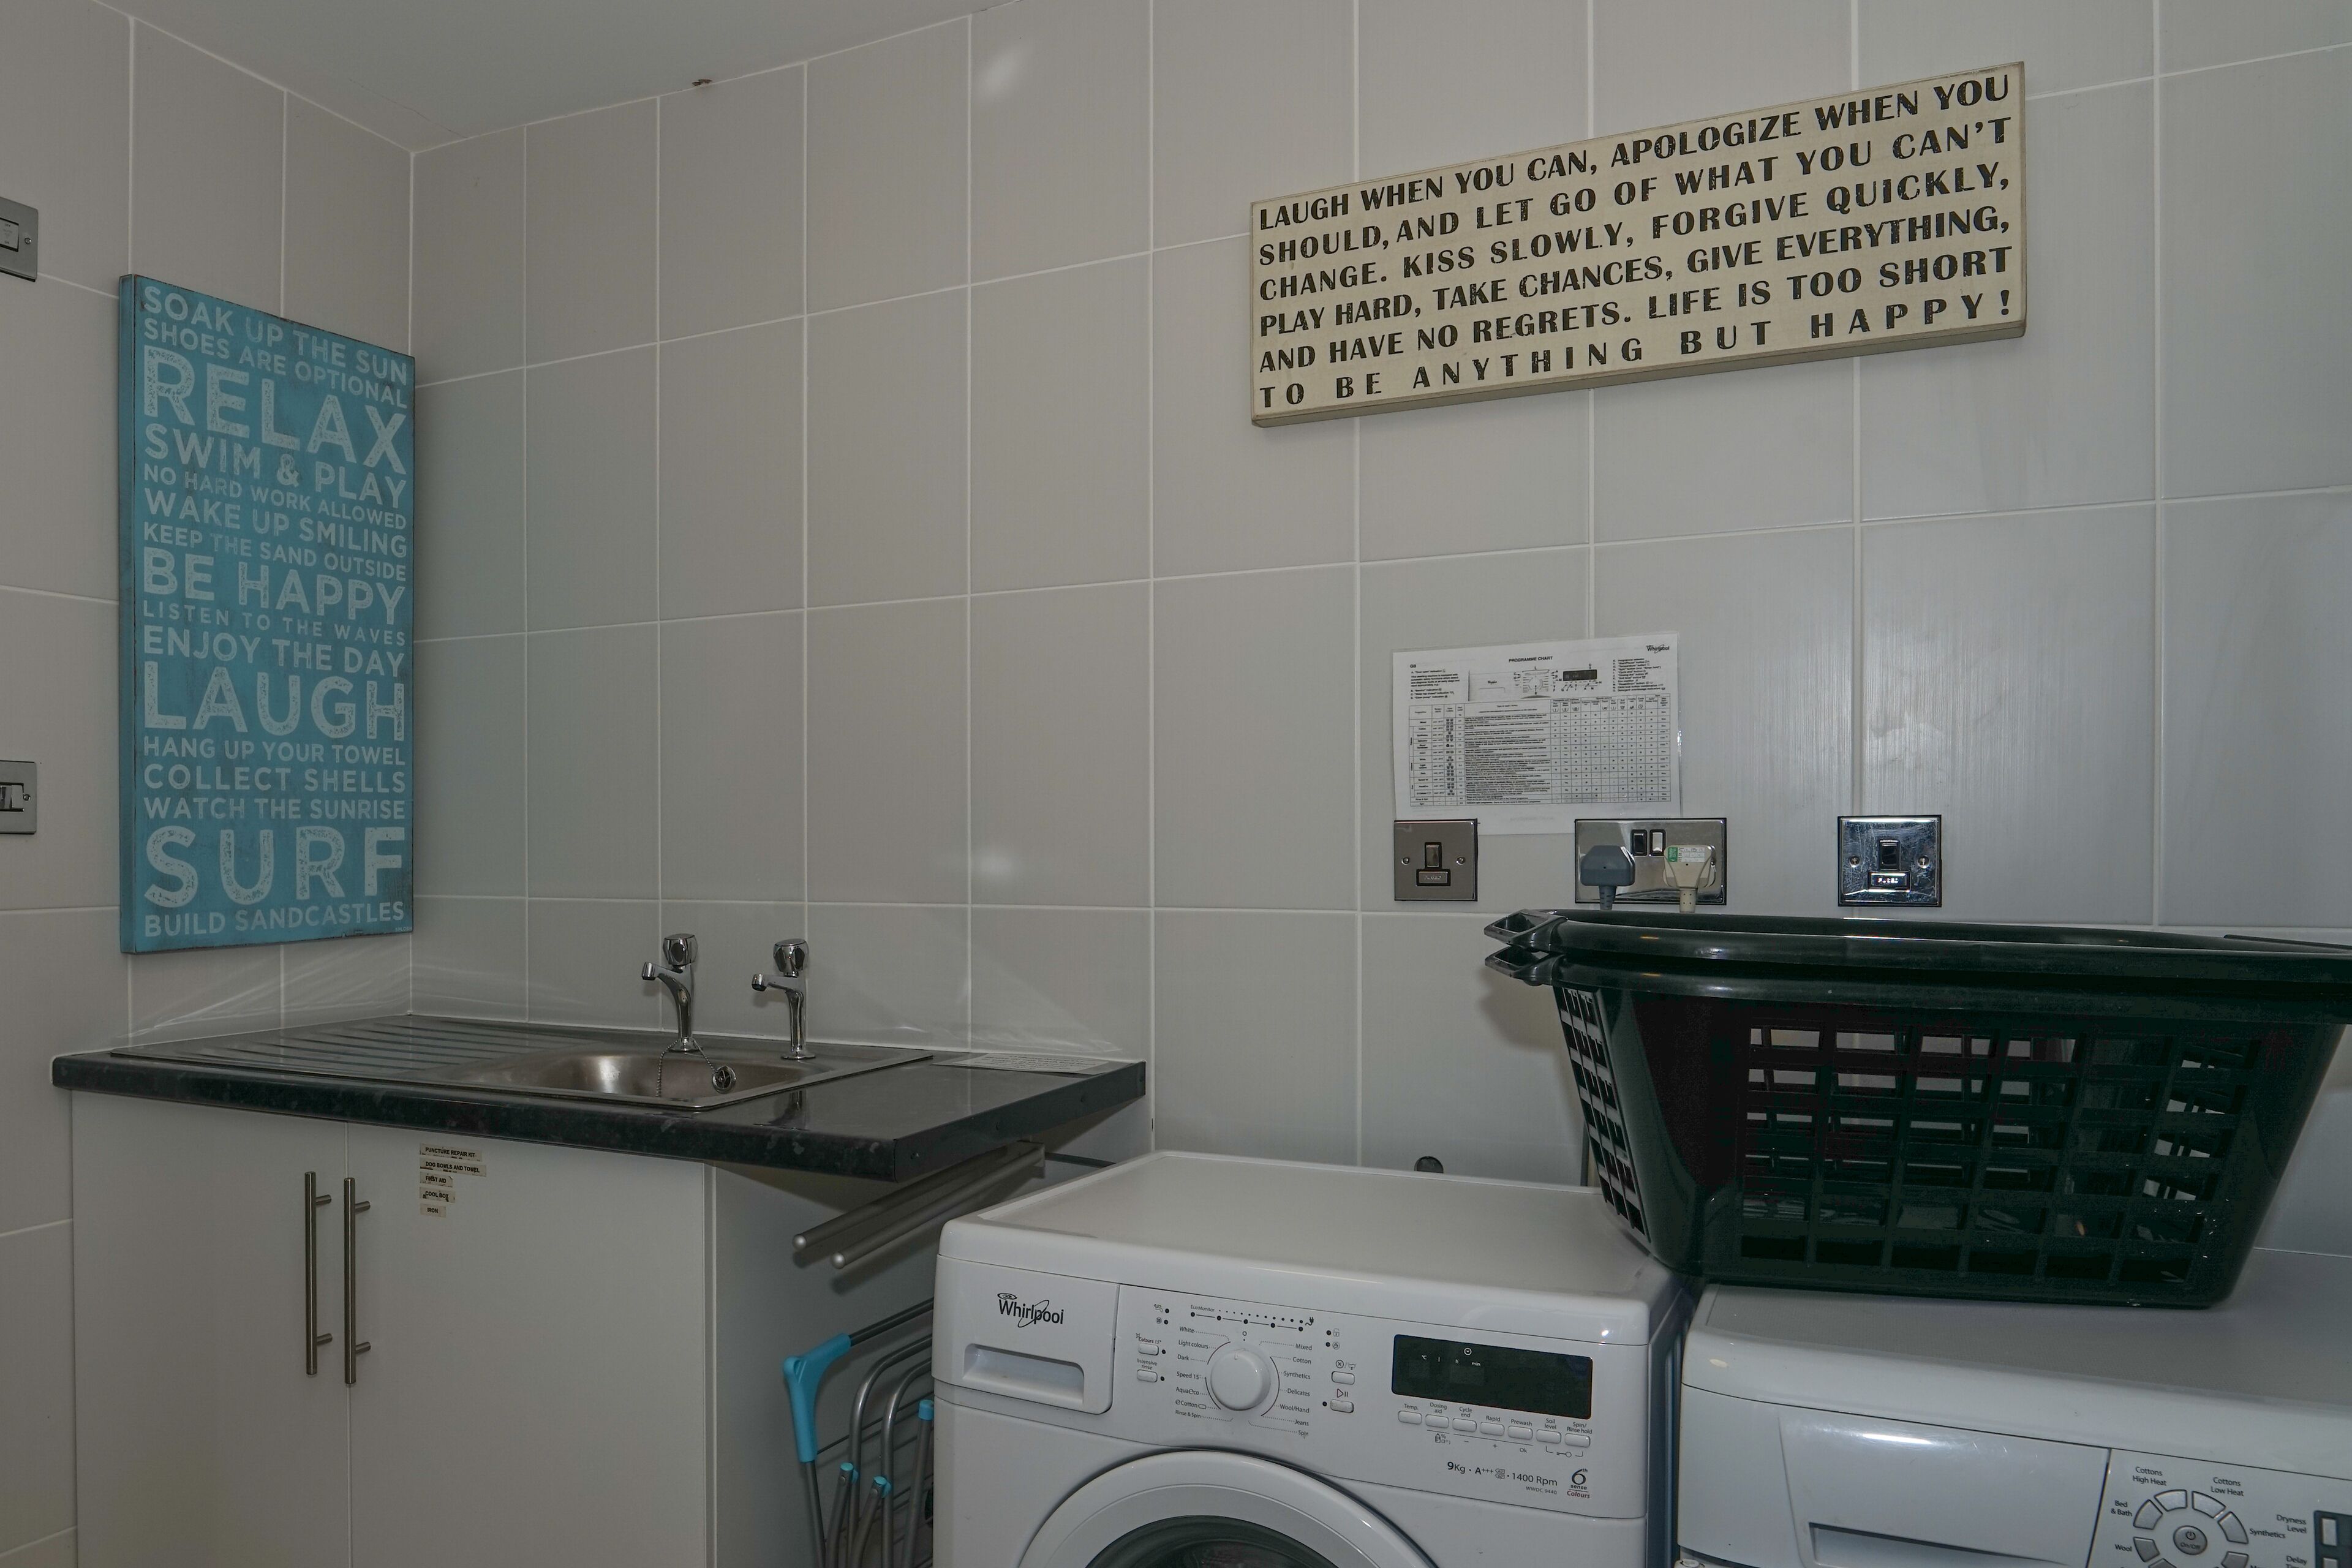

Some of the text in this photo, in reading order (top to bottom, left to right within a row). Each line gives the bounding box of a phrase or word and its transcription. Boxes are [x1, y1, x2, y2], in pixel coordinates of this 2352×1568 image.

[1260, 74, 2008, 230] LAUGH WHEN YOU CAN, APOLOGIZE WHEN YOU
[1260, 116, 2011, 266] SHOULD, AND LET GO OF WHAT YOU CAN'T
[1260, 162, 2009, 301] CHANGE. KISS SLOWLY, FORGIVE QUICKLY,
[1261, 206, 2009, 336] PLAY HARD, TAKE CHANCES, GIVE EVERYTHING,
[1260, 246, 2012, 373] AND HAVE NO REGRETS. LIFE IS TOO SHORT
[145, 286, 407, 385] SOAK UP THE SUN
[145, 318, 407, 409] SHOES ARE OPTIONAL
[1260, 382, 1305, 408] TO
[1336, 372, 1382, 399] BE
[1413, 337, 1642, 389] ANYTHING
[1681, 320, 1771, 355] BUT
[144, 345, 407, 475] RELAX
[145, 423, 406, 509] SWIM & PLAY
[145, 464, 406, 530] NO HARD WORK ALLOWED
[145, 488, 407, 558] WAKE UP SMILING
[144, 522, 407, 582] KEEP THE SAND OUTSIDE
[143, 548, 405, 625] BE HAPPY
[143, 600, 405, 646] LISTEN TO THE WAVES
[144, 625, 404, 677] ENJOY THE DAY
[144, 661, 404, 741] LAUGH
[144, 736, 405, 766] HANG UP YOUR TOWEL
[144, 763, 405, 793] COLLECT SHELLS
[144, 797, 405, 820] WATCH THE SUNRISE
[144, 825, 405, 908] SURF
[145, 901, 404, 937] BUILD SANDCASTLES
[998, 1299, 1064, 1325] Whirlpool
[1284, 1371, 1310, 1379] Synthetics
[1287, 1388, 1310, 1396] Delicates
[1280, 1404, 1310, 1413] Wool/Hand
[1447, 1461, 1465, 1474] 9Kg
[1512, 1472, 1534, 1482] 1400
[1536, 1476, 1558, 1486] Rpm
[2133, 1476, 2149, 1485] High
[2135, 1466, 2163, 1476] Cottons
[2213, 1477, 2241, 1487] Cottons
[1567, 1490, 1590, 1499] Colours
[2250, 1528, 2286, 1539] Synthetics
[2277, 1514, 2307, 1525] Dryness
[2287, 1525, 2307, 1534] Level
[2286, 1556, 2307, 1564] Delay
